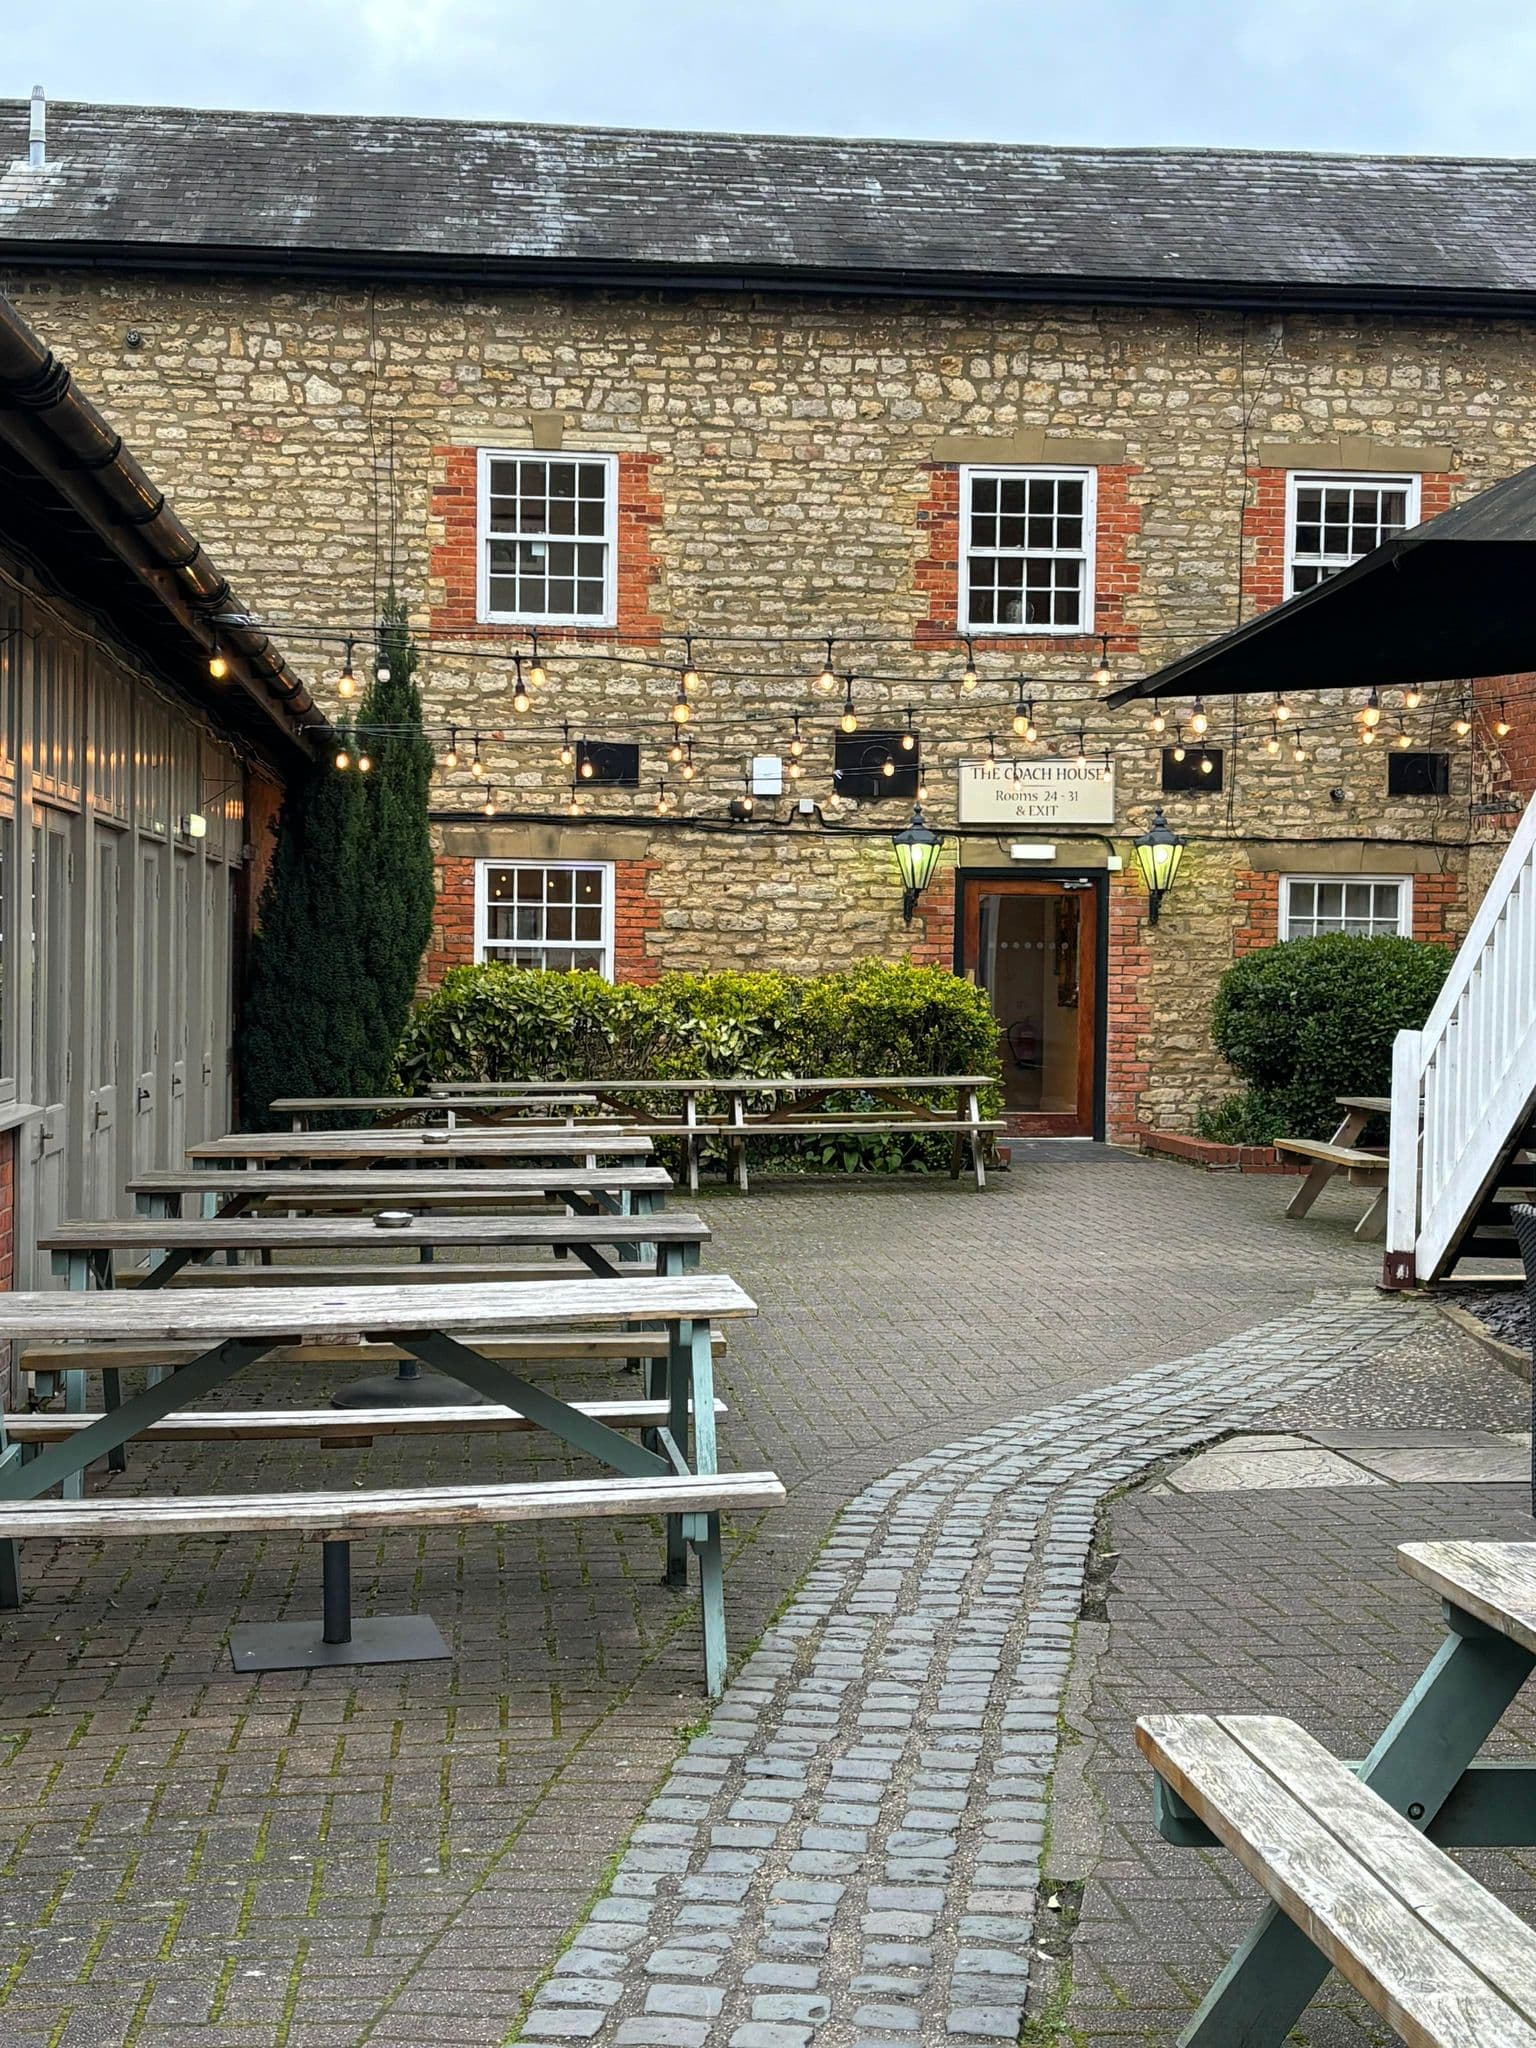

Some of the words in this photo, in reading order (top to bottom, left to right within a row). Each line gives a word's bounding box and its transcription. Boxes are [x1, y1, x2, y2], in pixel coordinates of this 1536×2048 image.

[971, 767, 1000, 780] THE
[1004, 767, 1051, 781] COACH
[1056, 767, 1105, 781] HOUSE
[995, 790, 1038, 801] Rooms
[1043, 791, 1057, 801] 24
[1068, 791, 1079, 802] 31
[1016, 805, 1026, 816] &
[1029, 805, 1059, 817] EXIT
